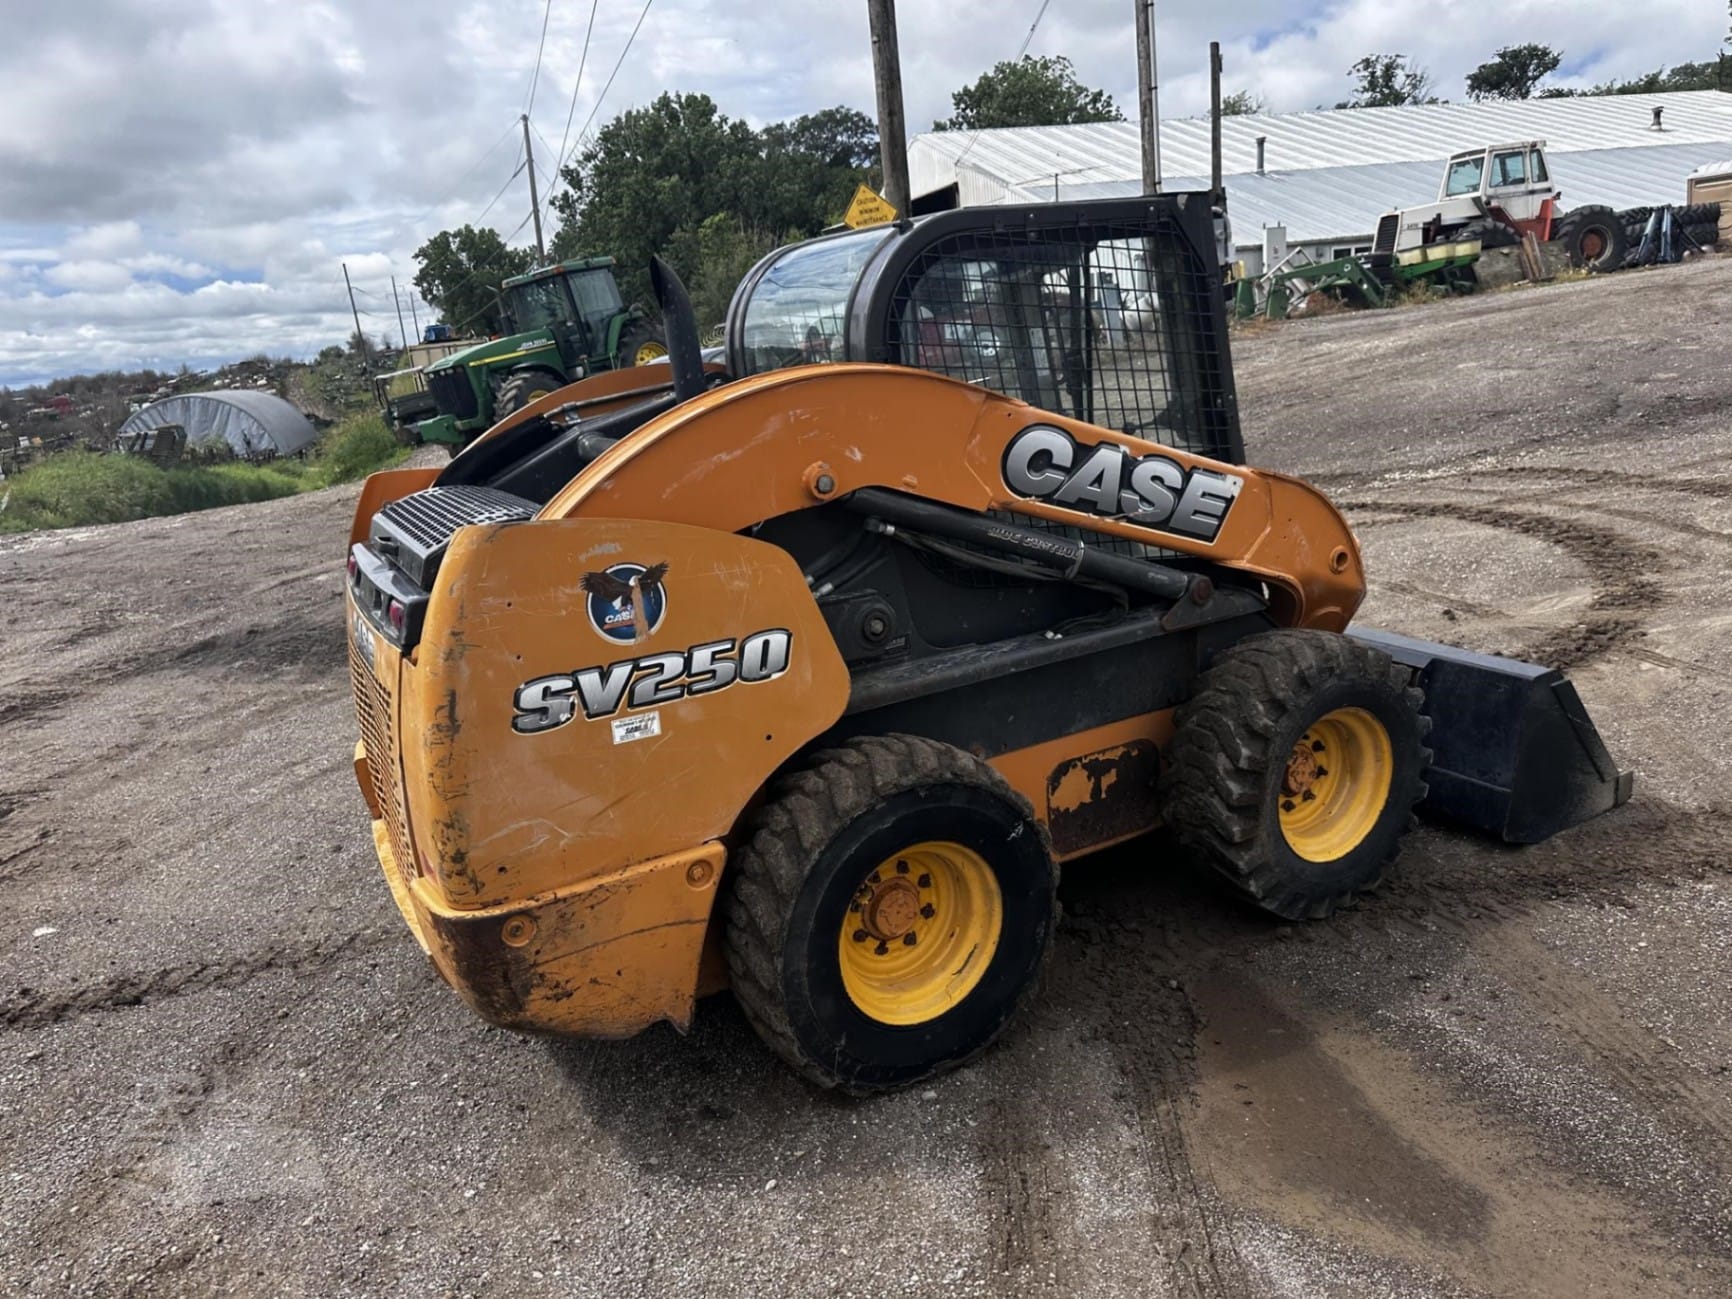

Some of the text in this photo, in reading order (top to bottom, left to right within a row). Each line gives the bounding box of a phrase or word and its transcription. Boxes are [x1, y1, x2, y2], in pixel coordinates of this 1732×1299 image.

[1002, 425, 1237, 538] CASE
[604, 610, 635, 624] CAS
[512, 627, 793, 734] SV250
